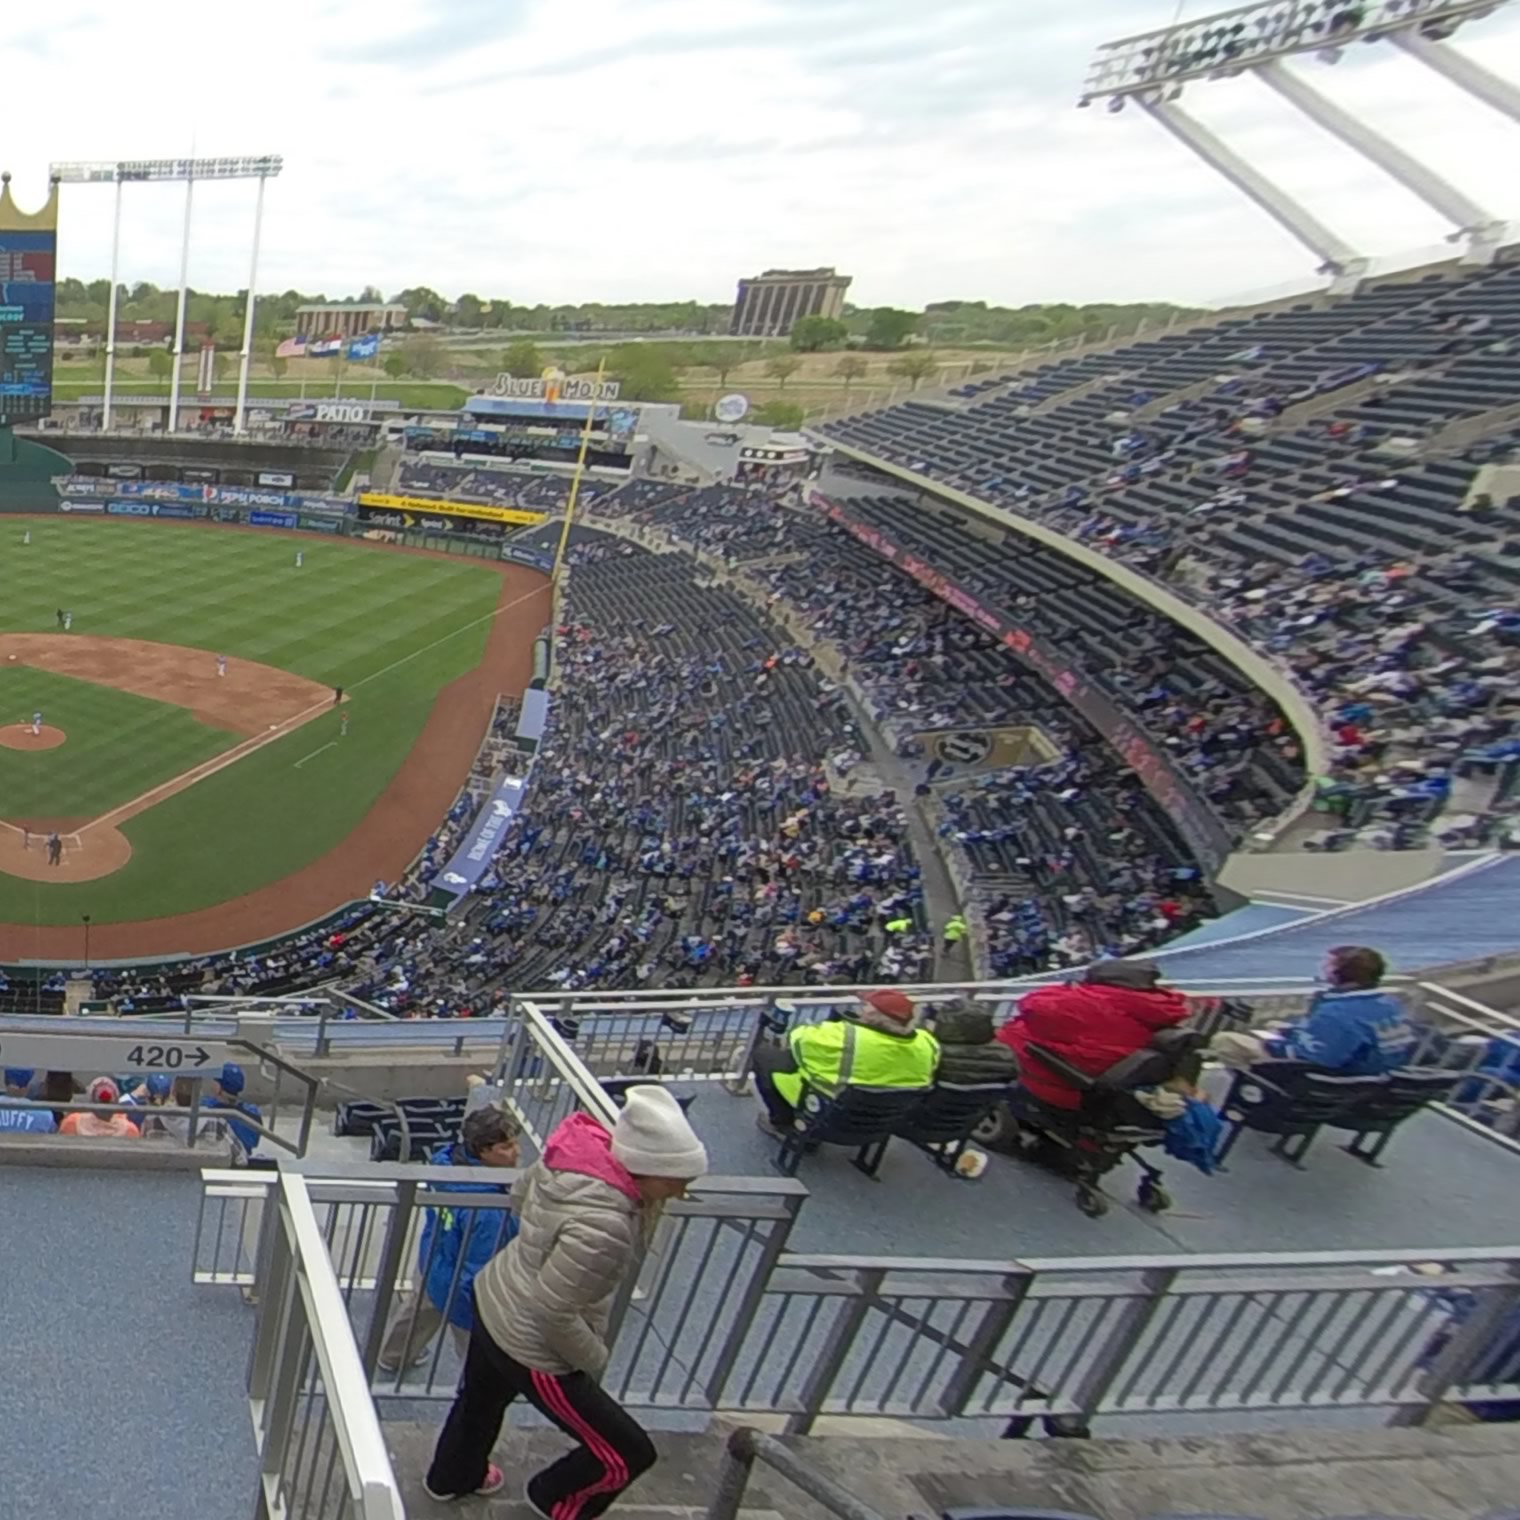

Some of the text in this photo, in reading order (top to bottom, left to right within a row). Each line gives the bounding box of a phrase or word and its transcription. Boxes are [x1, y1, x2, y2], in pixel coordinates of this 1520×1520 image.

[493, 372, 620, 399] BLUE MOON
[315, 404, 364, 421] PATIO
[108, 503, 150, 514] GEICO
[369, 512, 402, 527] Sprint
[127, 1045, 183, 1068] 420
